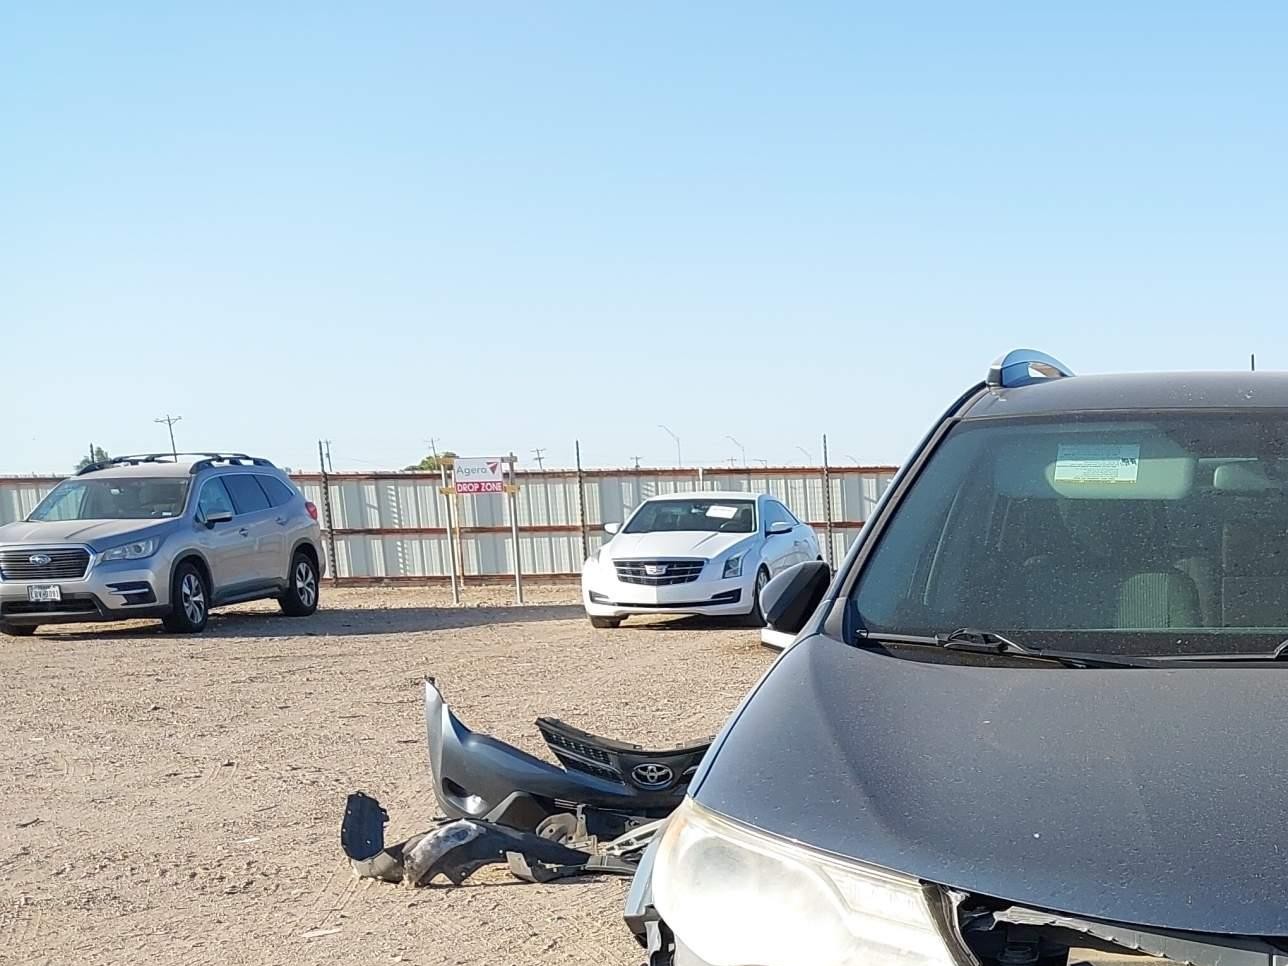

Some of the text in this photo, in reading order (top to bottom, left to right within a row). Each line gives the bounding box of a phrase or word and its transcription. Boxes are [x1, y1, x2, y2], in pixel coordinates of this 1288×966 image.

[457, 465, 487, 476] Agero
[457, 482, 502, 492] DROP ZONE
